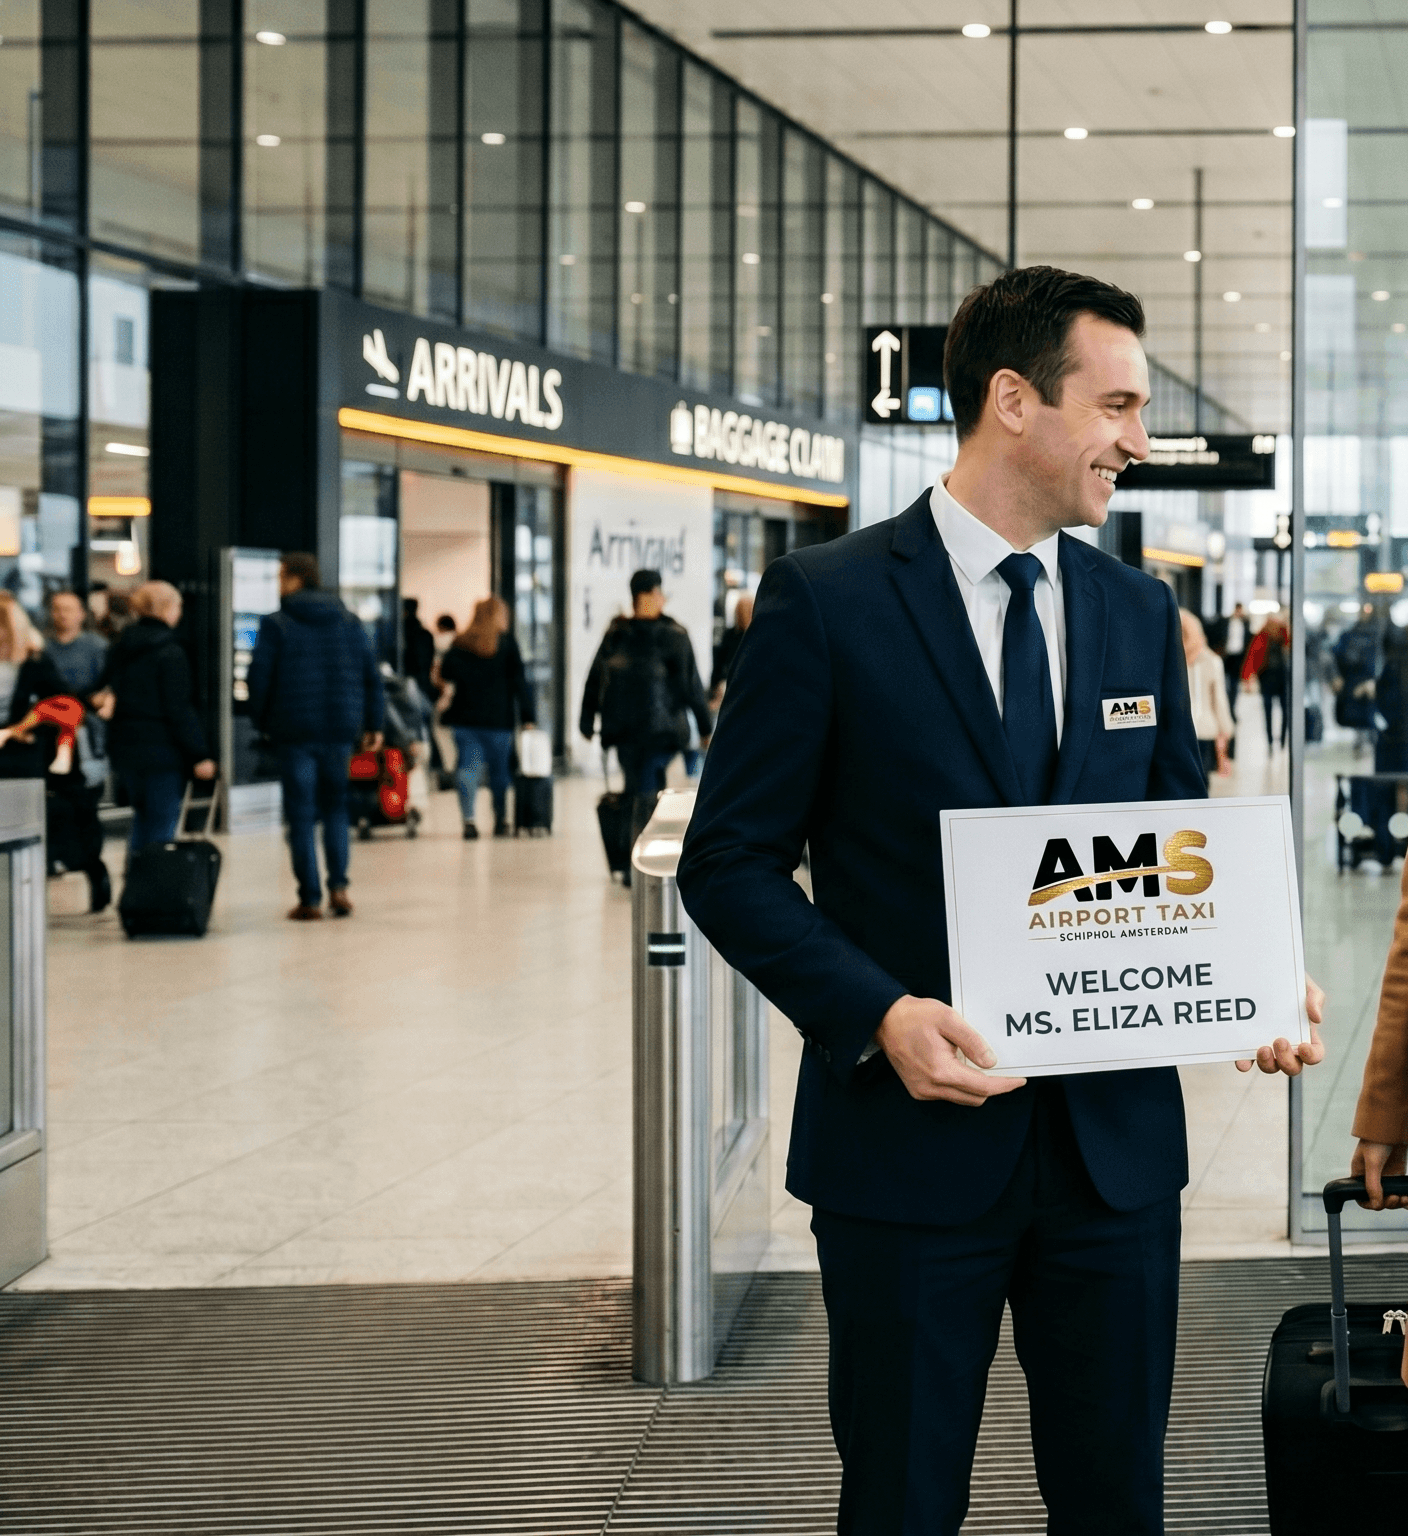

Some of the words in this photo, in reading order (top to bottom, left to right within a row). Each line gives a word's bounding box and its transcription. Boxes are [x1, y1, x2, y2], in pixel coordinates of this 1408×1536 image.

[407, 337, 564, 431] ARRIVALS
[694, 404, 790, 475] BAGGAGE
[1109, 699, 1151, 716] AMS
[1027, 829, 1214, 906] AMS
[1028, 906, 1147, 931] AIRPORT
[1156, 901, 1216, 922] TAXI
[1059, 930, 1117, 942] SCHIPHOL
[1120, 925, 1189, 939] AMSTERDAM
[1045, 962, 1213, 997] WELCOME
[1005, 1010, 1062, 1037] MS.
[1072, 1003, 1164, 1032] ELIZA
[1173, 997, 1257, 1025] REED
